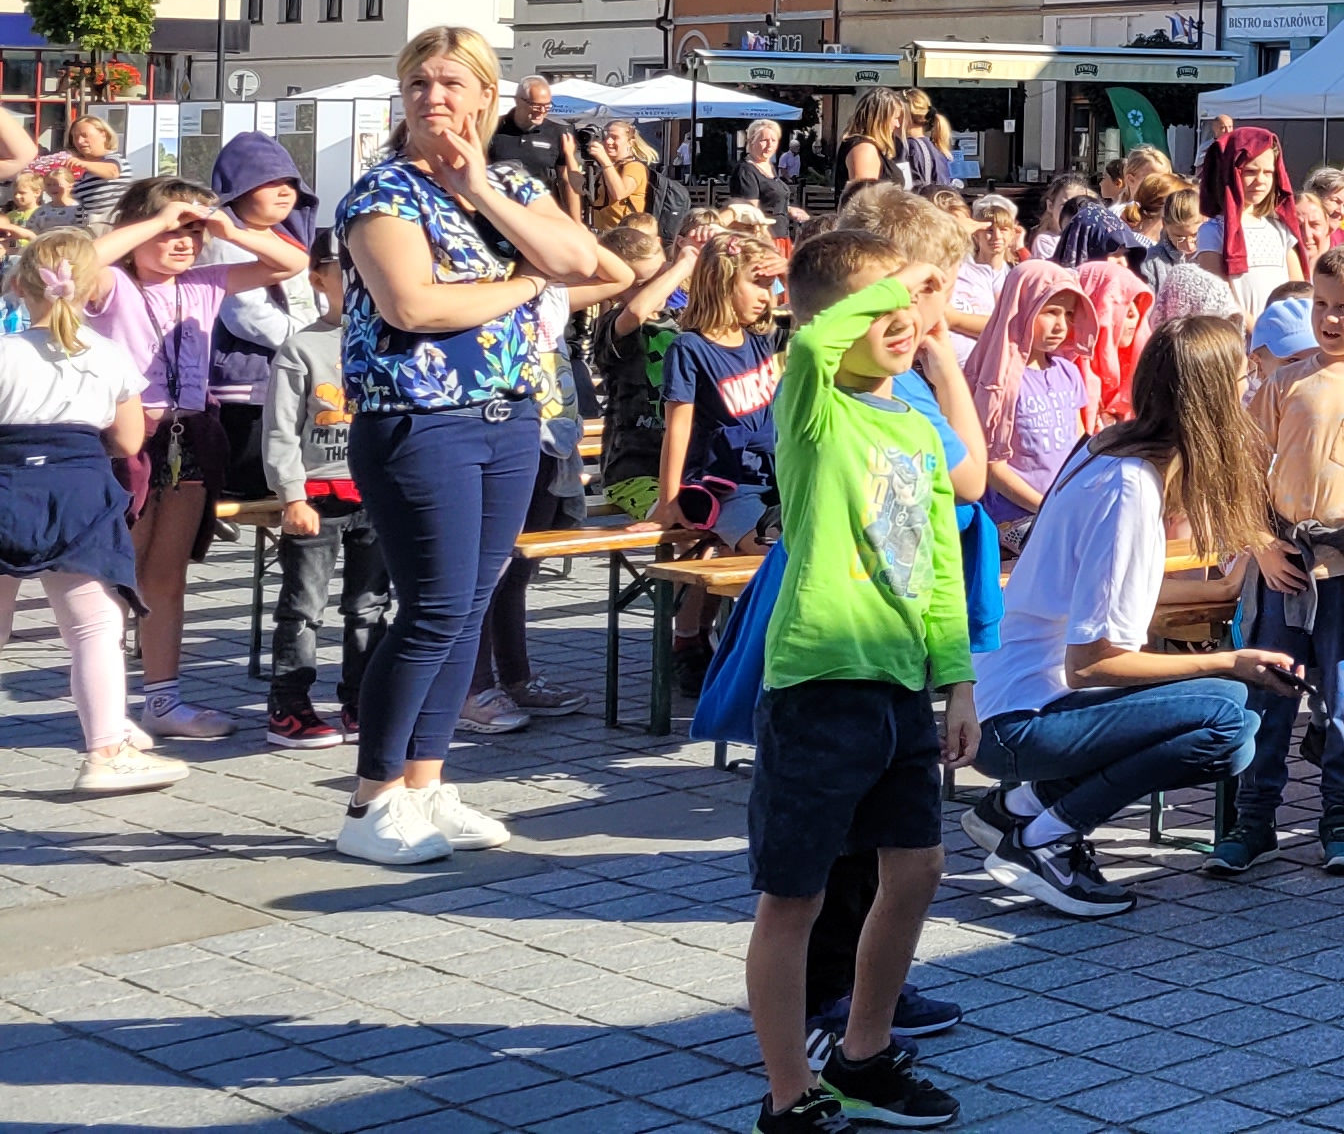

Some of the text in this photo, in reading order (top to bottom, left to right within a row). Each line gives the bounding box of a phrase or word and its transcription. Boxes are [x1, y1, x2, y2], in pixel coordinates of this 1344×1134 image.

[1228, 12, 1325, 28] BISTRO na STARÓWCE
[310, 427, 330, 444] I'M
[324, 445, 349, 462] THA
